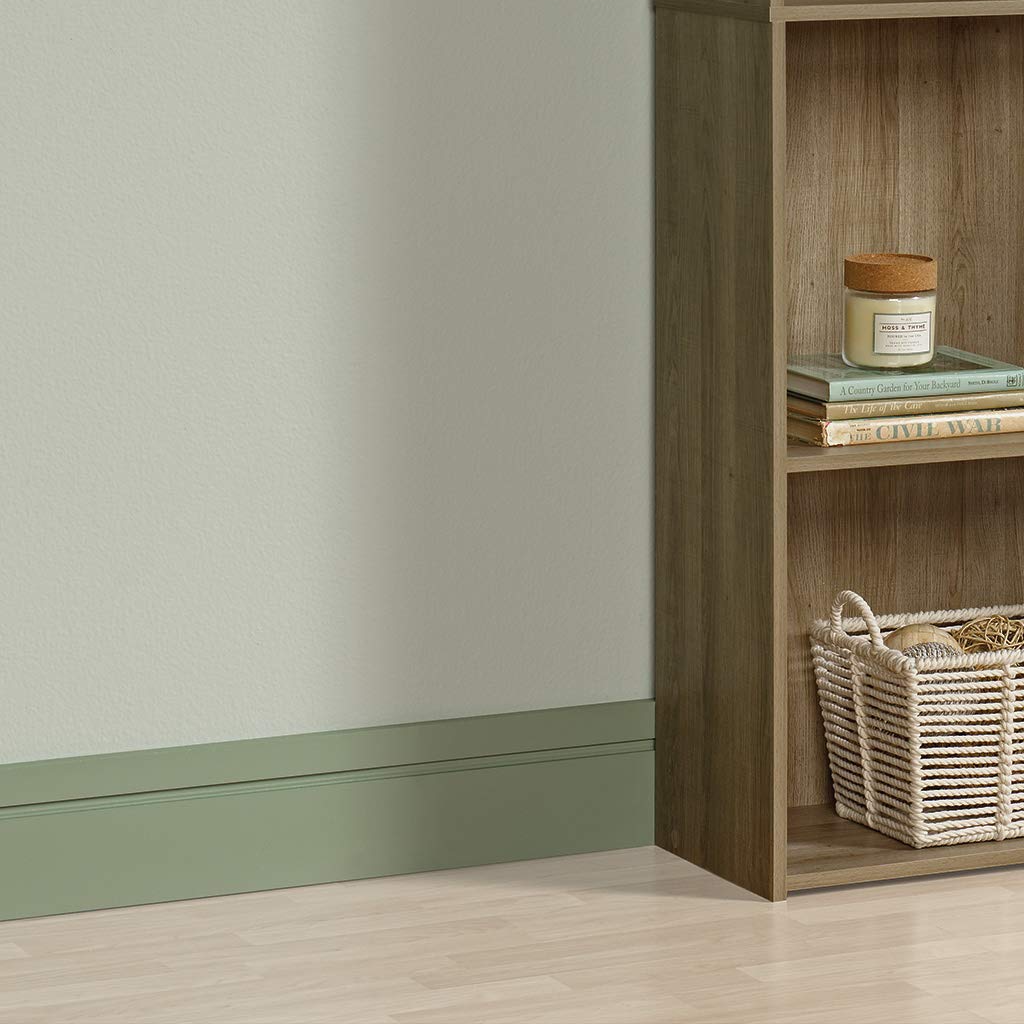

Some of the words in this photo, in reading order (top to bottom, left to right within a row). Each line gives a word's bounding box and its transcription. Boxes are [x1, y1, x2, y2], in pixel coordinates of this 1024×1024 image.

[840, 387, 846, 396] A
[848, 386, 875, 396] Country
[877, 383, 902, 394] Garden
[903, 382, 912, 392] for
[914, 381, 931, 391] Your
[931, 379, 961, 391] Backyard
[843, 406, 858, 414] The
[861, 404, 877, 414] Life
[879, 404, 887, 415] of
[890, 403, 902, 411] the
[875, 422, 940, 441] CIVIL
[947, 417, 1002, 435] WAR
